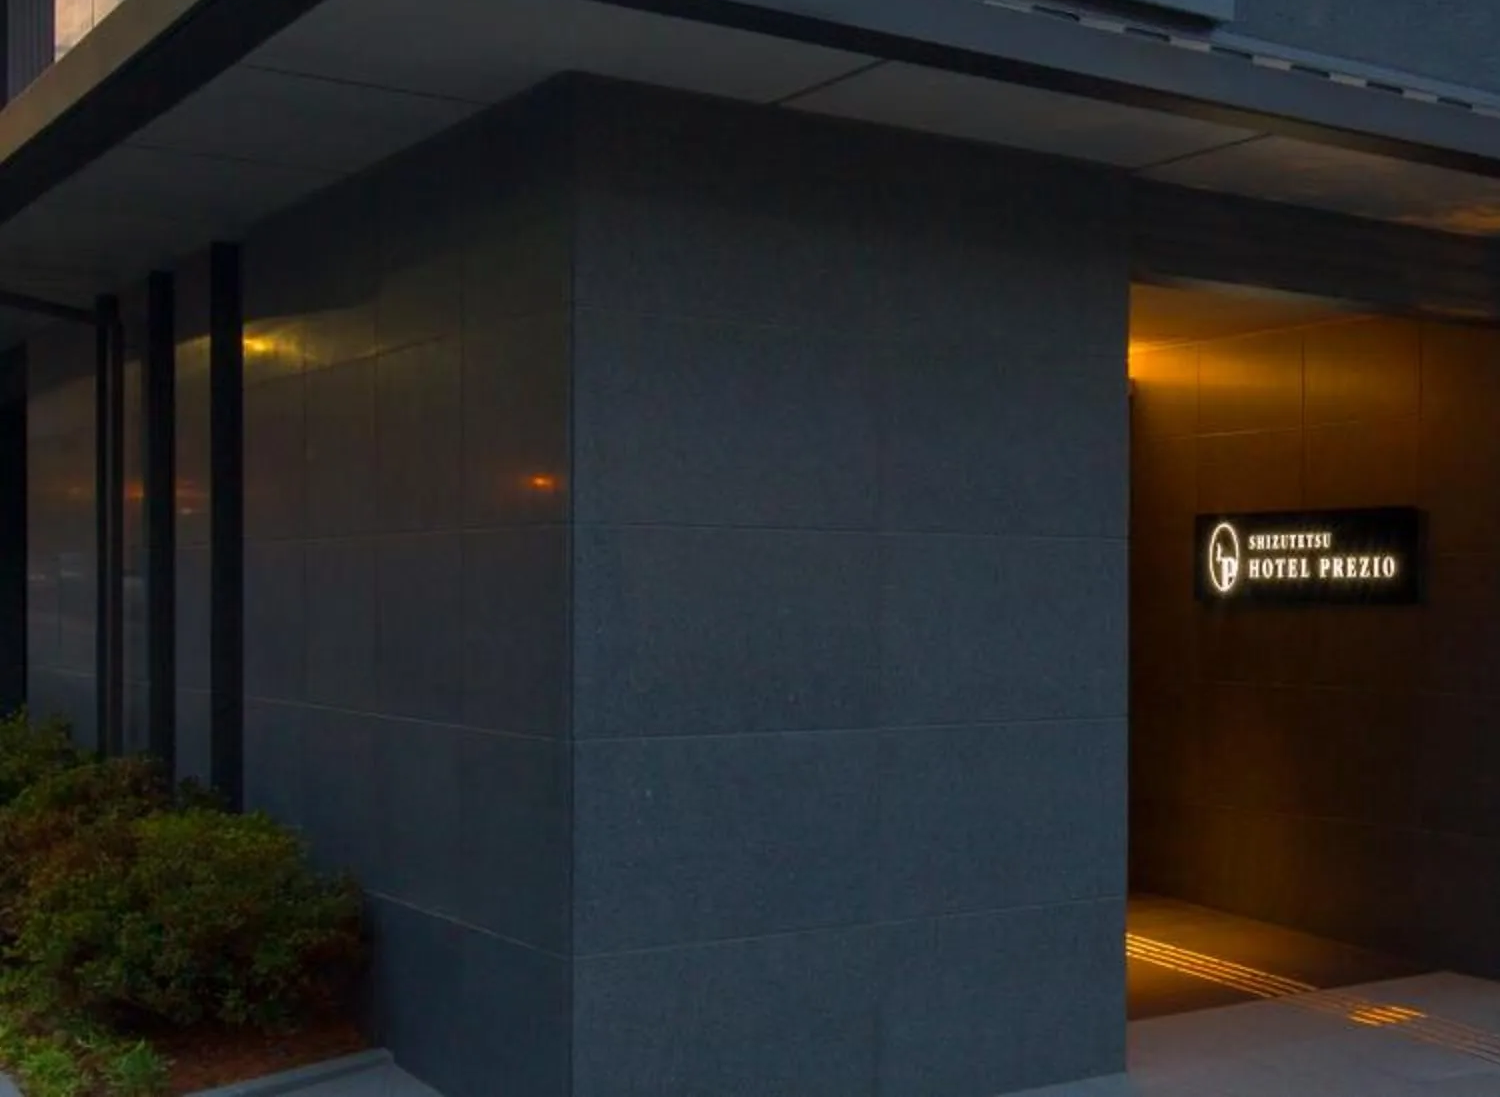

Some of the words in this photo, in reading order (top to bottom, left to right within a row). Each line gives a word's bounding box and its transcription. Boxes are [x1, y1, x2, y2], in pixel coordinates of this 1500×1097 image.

[1249, 533, 1332, 551] SHIZUTETSU
[1249, 557, 1310, 579] HOTEL
[1319, 555, 1397, 579] PREZIO
